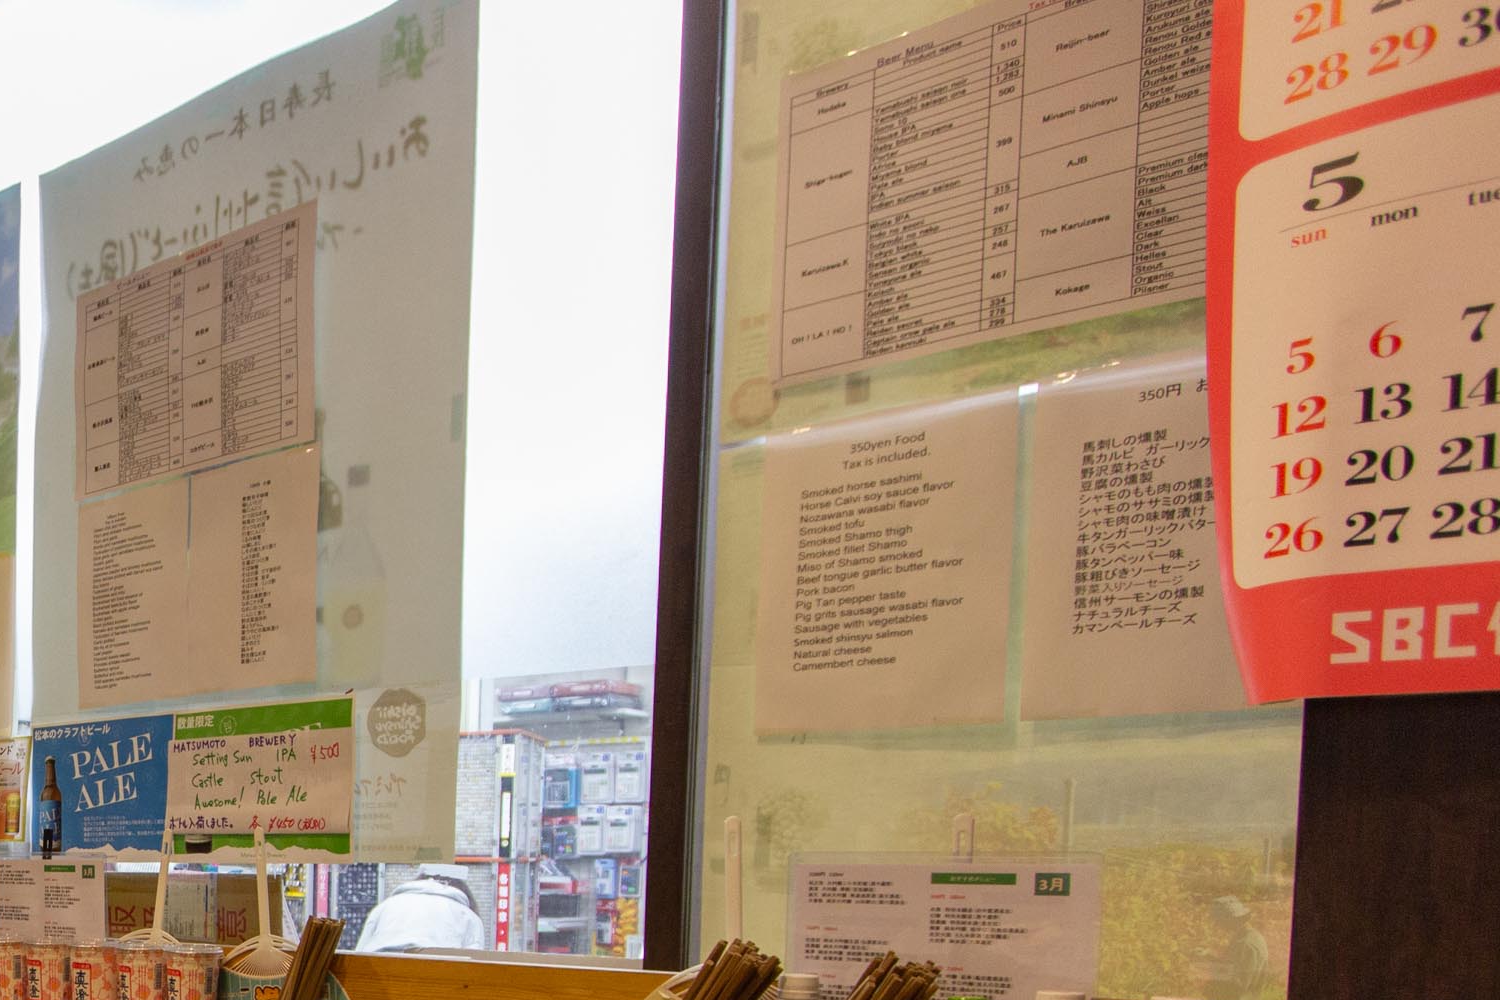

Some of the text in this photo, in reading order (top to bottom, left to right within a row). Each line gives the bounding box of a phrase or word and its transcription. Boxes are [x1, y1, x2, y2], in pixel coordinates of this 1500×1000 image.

[1292, 0, 1346, 44] 21
[877, 41, 934, 68] Beer Menu
[1144, 45, 1199, 66] Golden ale
[1284, 24, 1437, 105] 28 29
[1143, 57, 1196, 77] Amber ale
[1142, 85, 1176, 98] Porter
[1043, 95, 1118, 123] Minami Shinsyu
[1138, 184, 1166, 197] Black
[1302, 152, 1364, 211] 5
[1040, 214, 1110, 238] The Karuizawa
[1136, 229, 1163, 241] Clear
[1291, 227, 1327, 248] sun
[1370, 205, 1418, 227] mon
[1135, 251, 1166, 262] Helles
[1136, 241, 1160, 251] Dark
[1135, 271, 1174, 284] Organic
[1136, 262, 1163, 273] Stout
[1055, 284, 1090, 296] Kokage
[1134, 283, 1170, 295] Pilsner
[1286, 303, 1495, 375] 5 6 7
[1139, 383, 1181, 402] 350円
[1271, 367, 1500, 439] 12 13 14
[851, 431, 926, 454] 350yen Food
[843, 446, 931, 470] Tax is included.
[1080, 456, 1165, 480] 野沢菜わさび
[1269, 433, 1500, 499] 19 20 21
[802, 471, 922, 500] Smoked horse sashimi
[800, 508, 854, 523] Nozawana
[858, 500, 896, 515] wasabi
[799, 524, 913, 549] Smoked Shamo thigh
[800, 519, 865, 536] Smoked tofu
[1263, 498, 1500, 559] 26 27 28
[1076, 539, 1171, 558] 豚バラベーコン
[797, 549, 923, 574] Miso of Shamo smoked
[797, 573, 821, 586] Beef
[824, 570, 860, 584] tongue
[862, 566, 893, 579] garlic
[896, 562, 927, 574] butter
[796, 583, 855, 598] Pork bacon
[796, 589, 906, 611] Pig Tan pepper taste
[795, 612, 812, 623] Pig
[840, 605, 885, 618] sausage
[889, 599, 928, 612] wasabi
[1073, 602, 1181, 622] ナチュラルチーズ
[794, 612, 928, 635] Sausage with vegetables
[1072, 613, 1196, 635] カマンベールチーズ
[794, 627, 913, 647] Smoked shinsyu salmon
[793, 654, 896, 672] Camembert cheese
[794, 645, 872, 660] Natural cheese
[34, 723, 110, 741] 松本のクラフトビール
[177, 715, 214, 730] 数量限定
[173, 734, 296, 753] MATSUMOTO BREWERY
[70, 733, 152, 780] PALE
[192, 752, 228, 767] Setting
[234, 751, 252, 763] Sun
[276, 748, 297, 762] IPA
[192, 773, 223, 788] Castle
[74, 772, 137, 812] ALE
[257, 789, 277, 805] Pale
[286, 785, 307, 806] Ale
[269, 817, 295, 832] ¥450
[1038, 877, 1064, 892] 3月
